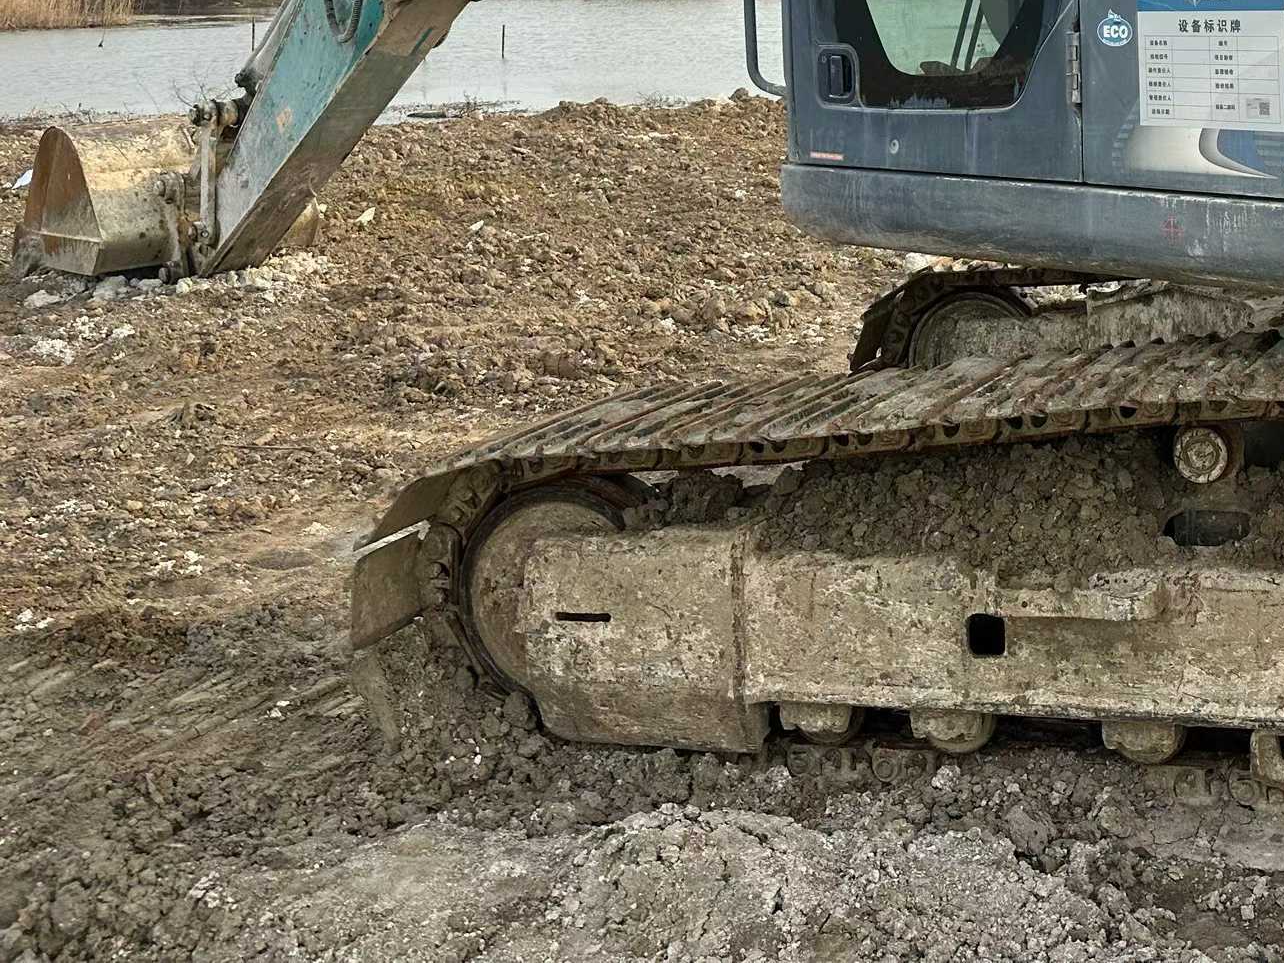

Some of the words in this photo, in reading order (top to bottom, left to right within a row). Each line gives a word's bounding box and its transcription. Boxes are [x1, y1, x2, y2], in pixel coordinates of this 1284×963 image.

[1103, 25, 1128, 39] ECO
[1178, 19, 1242, 33] 设备标识牌
